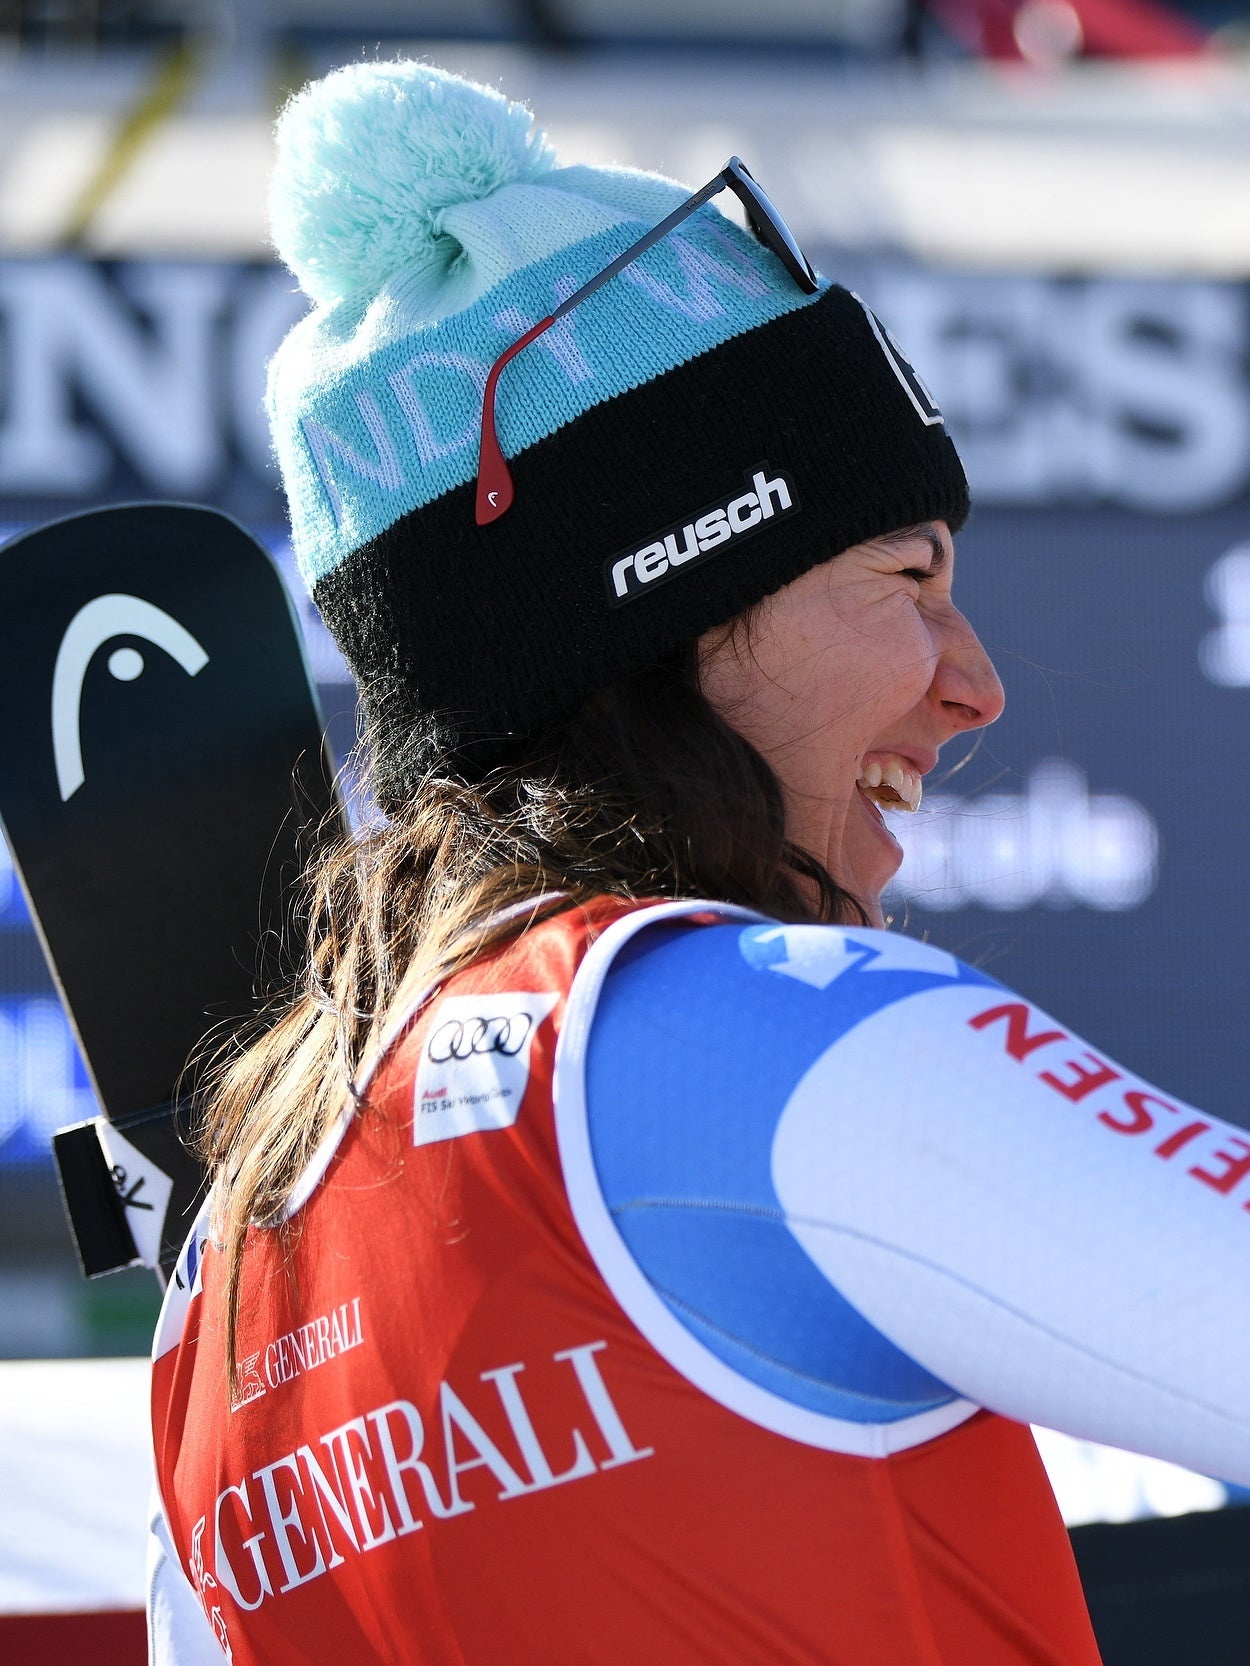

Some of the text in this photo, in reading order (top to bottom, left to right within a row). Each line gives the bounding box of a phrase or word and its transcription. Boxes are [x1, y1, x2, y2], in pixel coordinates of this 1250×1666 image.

[611, 471, 793, 597] reusch
[421, 1101, 438, 1114] FIS
[422, 1086, 448, 1100] Audi
[264, 1297, 365, 1390] GENERALI
[213, 1340, 655, 1612] GENERALI
